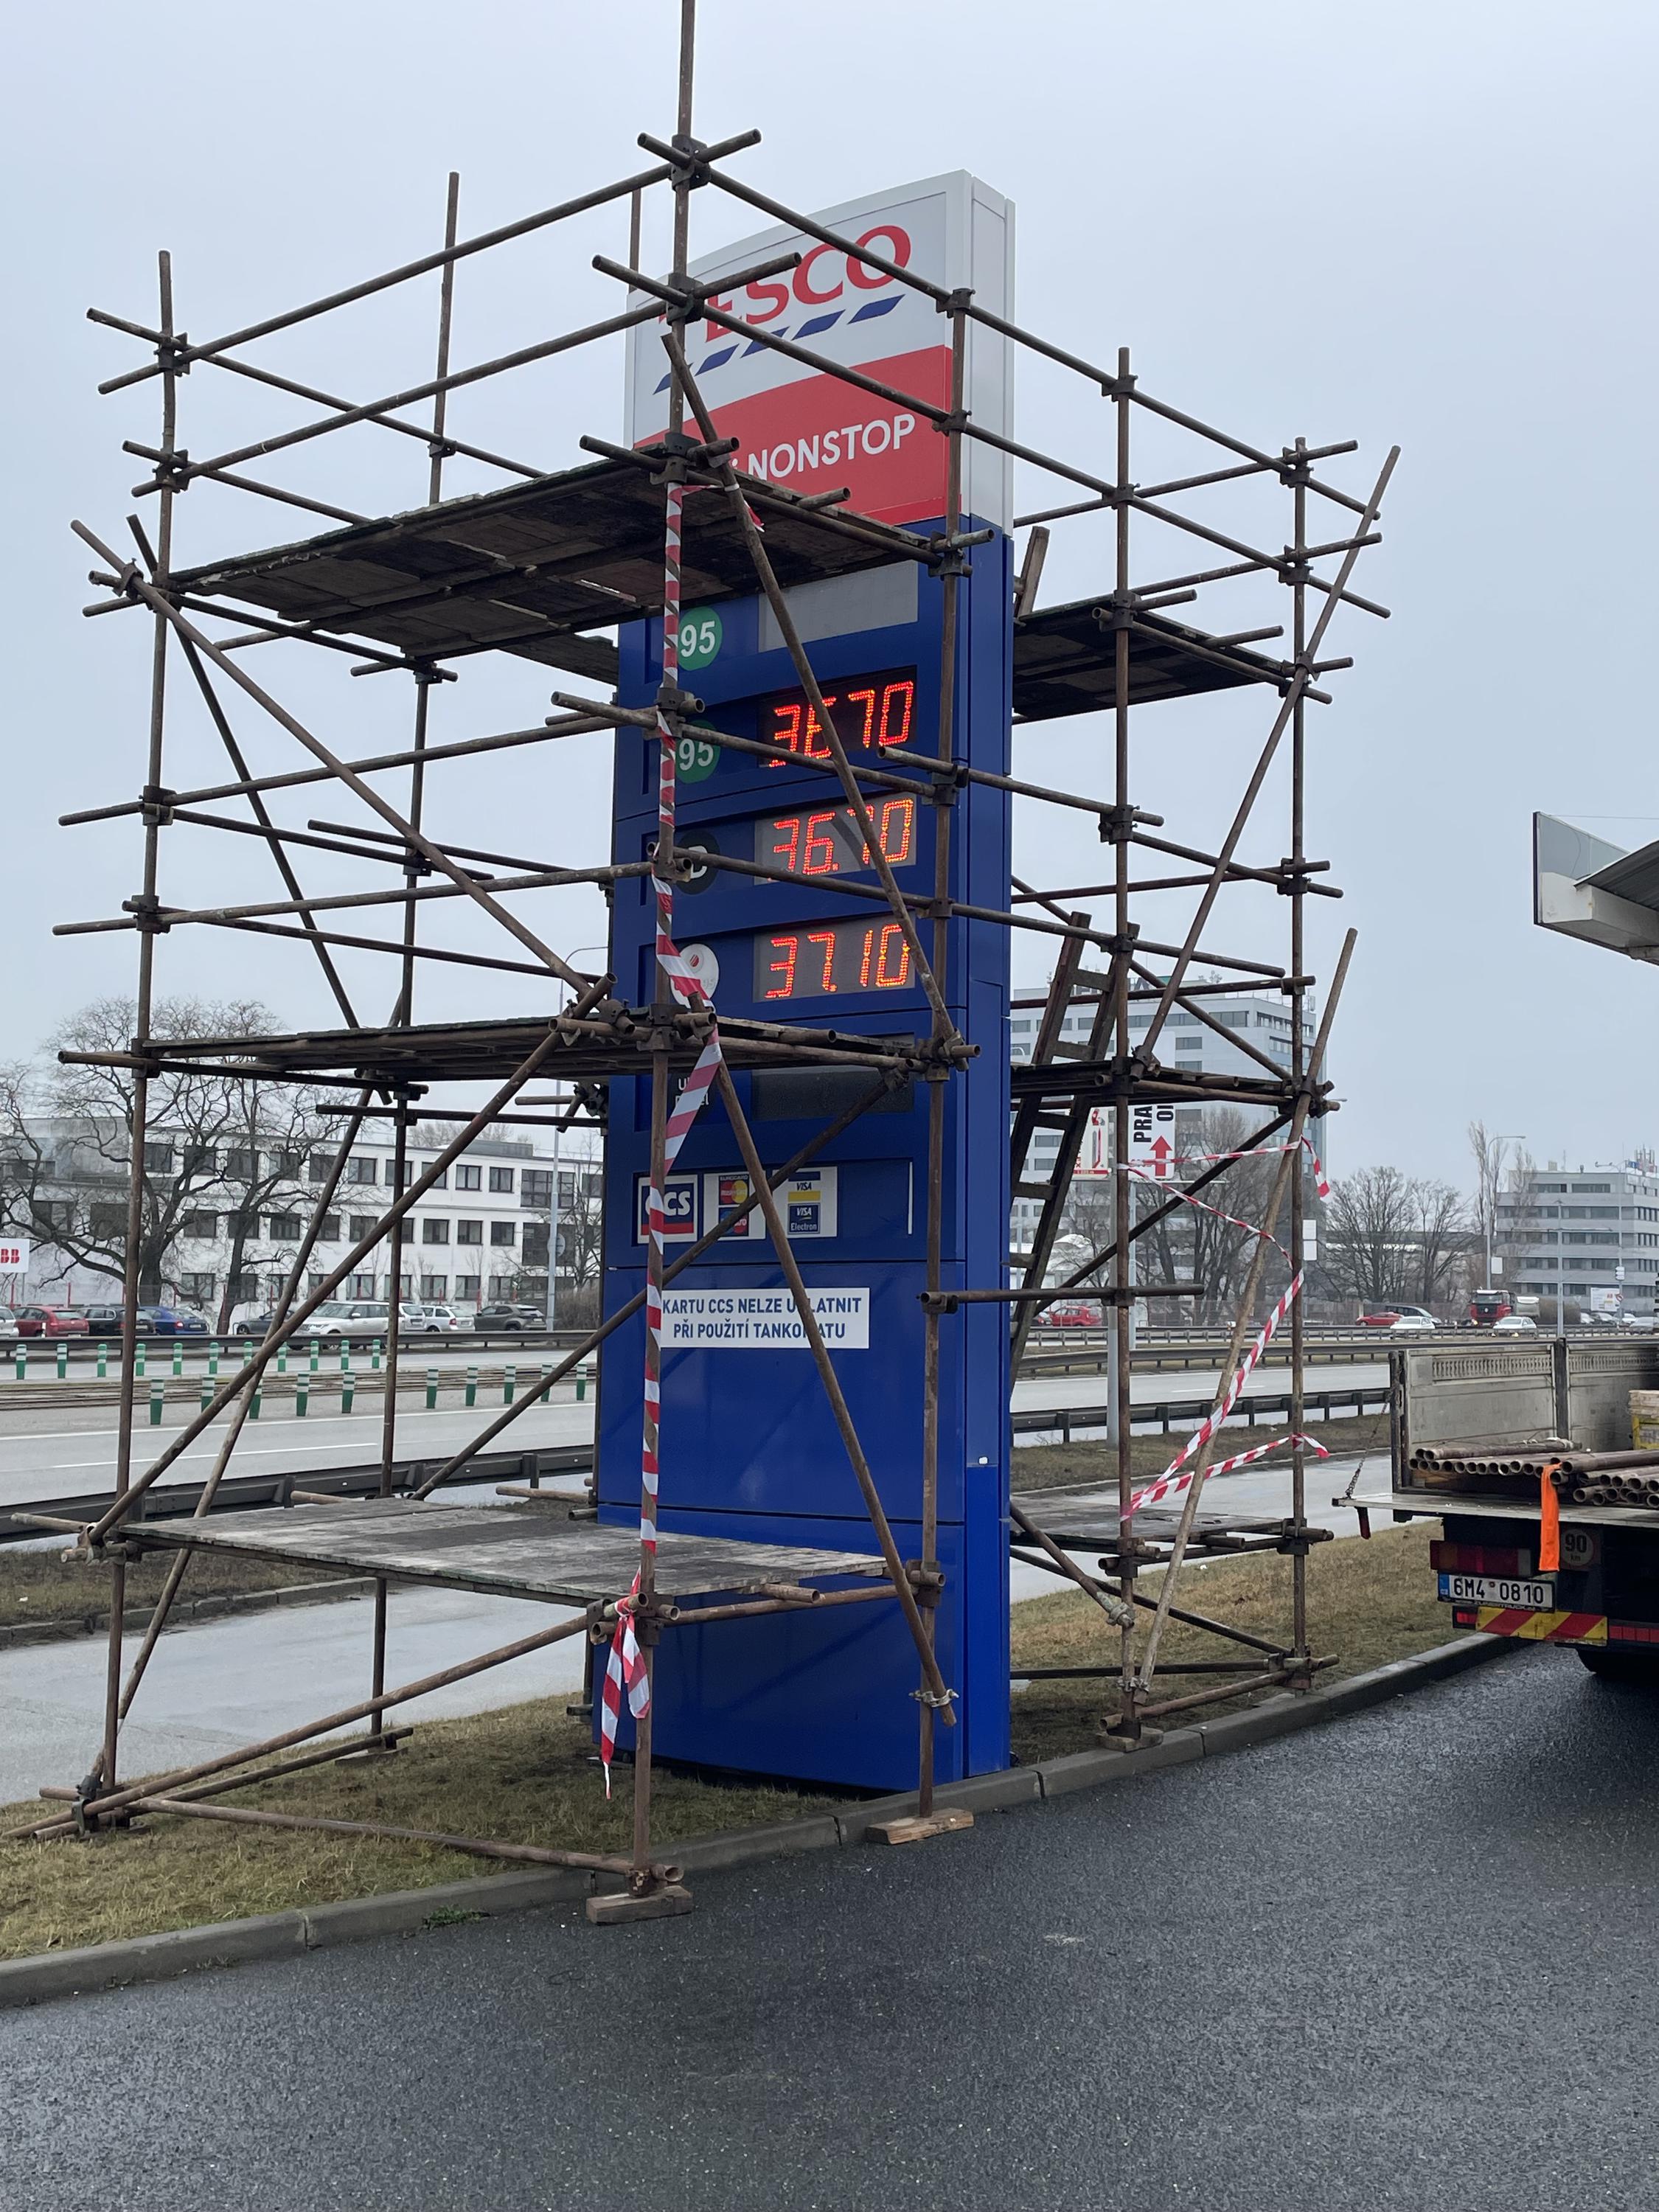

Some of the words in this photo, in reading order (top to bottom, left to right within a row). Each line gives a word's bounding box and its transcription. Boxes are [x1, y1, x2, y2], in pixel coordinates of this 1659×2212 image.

[658, 224, 911, 343] ESCO
[748, 413, 916, 481] NONSTOP
[680, 620, 716, 658] 95
[678, 734, 714, 771] 95
[764, 923, 911, 1000] 37.10
[796, 1182, 813, 1191] VISA
[796, 1207, 813, 1216] VISA
[790, 1222, 818, 1231] Electron
[663, 1299, 705, 1315] KARTU
[709, 1298, 734, 1314] CCS
[738, 1298, 782, 1314] NELZE
[787, 1297, 862, 1313] UATNIT
[674, 1318, 693, 1338] PŘI
[698, 1318, 750, 1339] POUŽITÍ
[1565, 1533, 1587, 1554] 90
[1571, 1554, 1582, 1562] km
[1454, 1578, 1485, 1599] 6M4
[1499, 1582, 1544, 1604] 0810
